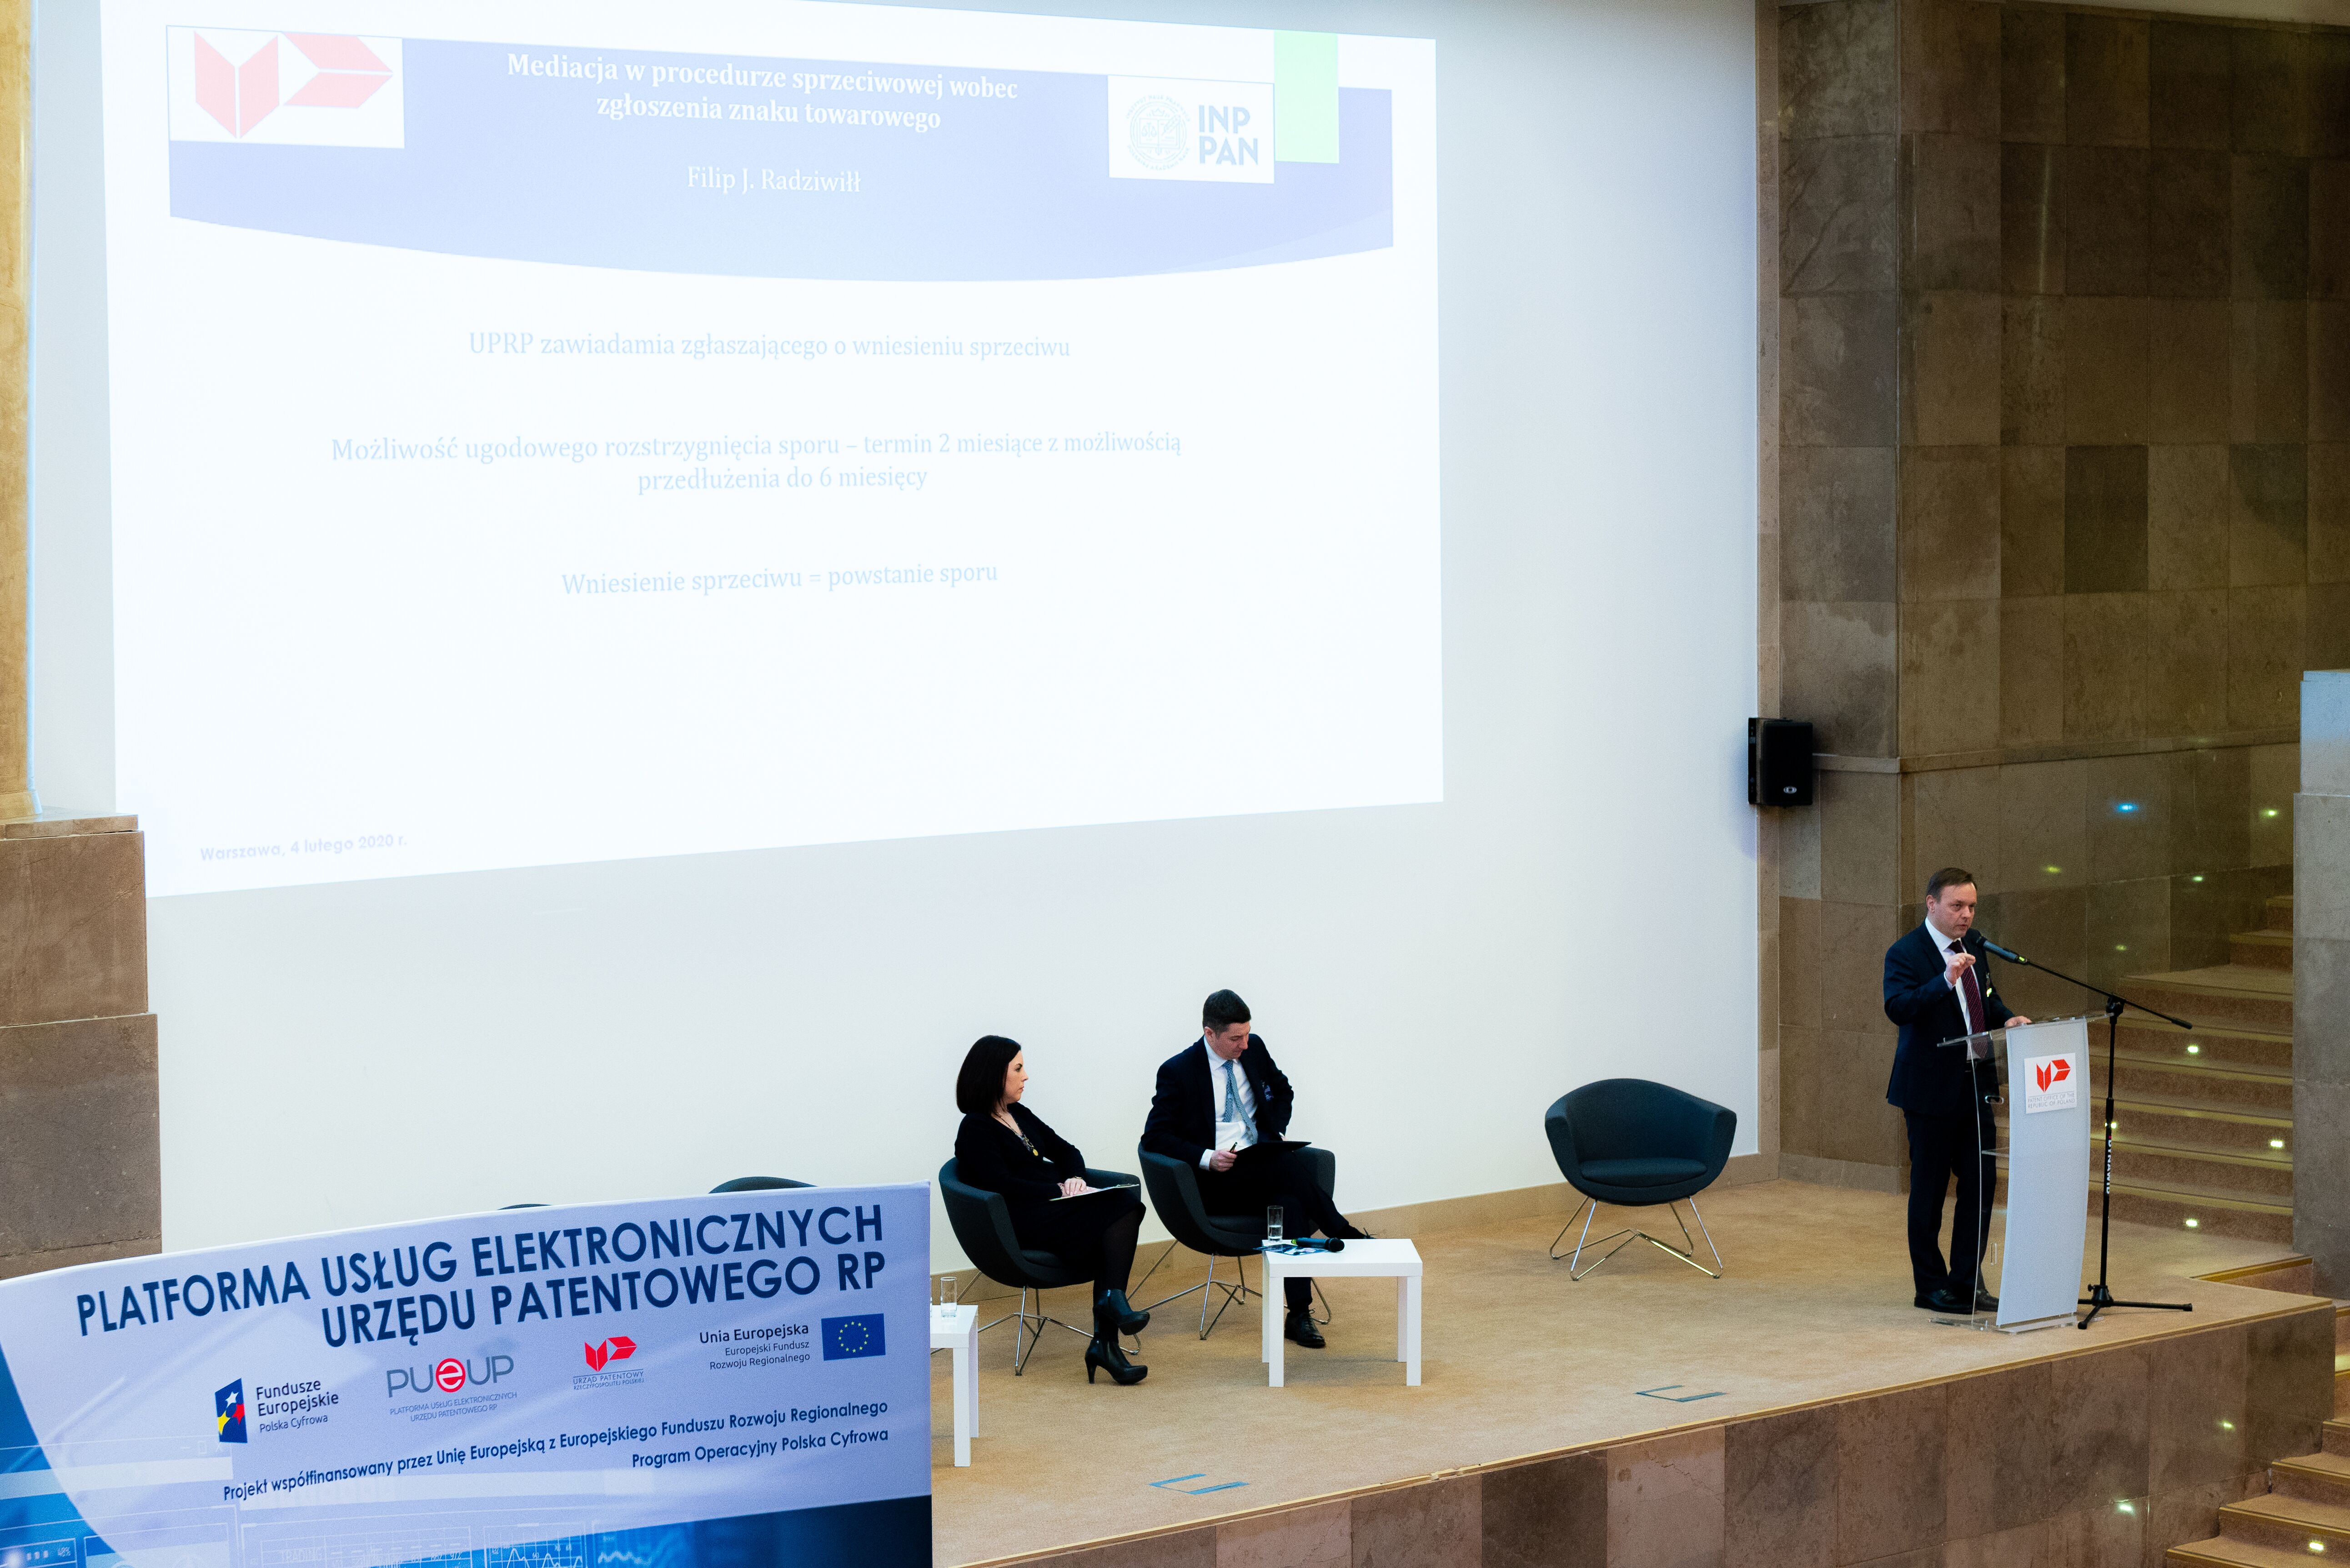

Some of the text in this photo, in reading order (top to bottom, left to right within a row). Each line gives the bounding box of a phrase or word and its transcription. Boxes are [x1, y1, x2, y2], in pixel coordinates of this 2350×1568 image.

[508, 54, 1017, 101] Mediacja w procedurze sprzeciwowej wobec
[597, 93, 940, 132] zgłoszenia znaku towarowego
[1199, 105, 1250, 134] INP
[1199, 136, 1258, 165] PAN
[688, 166, 860, 194] Filip J. Radziwiłł
[470, 332, 1070, 361] UPRP zawiadamia zgłaszającego o wniesieniu sprzeciwu
[332, 437, 457, 460] Możliwość
[466, 436, 598, 464] ugodowego
[606, 435, 771, 462] rozstrzygnięcia
[779, 440, 839, 460] sporu
[864, 433, 931, 453] termin
[939, 433, 949, 452] 2
[958, 433, 1042, 457] miesiące
[1048, 438, 1058, 452] z
[1065, 431, 1181, 456] możliwością
[638, 466, 927, 496] przedłużenia do 6 miesięcy
[562, 571, 685, 594] Wniesienie
[692, 568, 802, 596] sprzeciwu
[829, 564, 934, 592] powstanie
[940, 567, 997, 588] sporu
[200, 834, 407, 861] Warszawa, 4 lutego 2020 r.
[76, 1204, 885, 1336] PLATFORMA USŁUG ELEKTRONICZNYCH
[322, 1251, 885, 1347] URZĘDU PATENTOWEGO RP
[700, 1323, 810, 1343] Unia Europejska
[710, 1353, 811, 1371] Rozwoju Regionalnego
[725, 1341, 809, 1356] Europejski Fundusz
[256, 1381, 321, 1401] Fundusze
[573, 1371, 644, 1384] URZĄD PATENTOWY
[574, 1382, 620, 1390] RZECZYPOSPOLITEJ
[258, 1392, 338, 1417] Europejskie
[390, 1392, 517, 1415] PLATFORMA USŁUG ELEKTRONICZNYCH
[410, 1412, 437, 1422] URZĘDU
[438, 1406, 487, 1418] PATENTOWEGO
[259, 1415, 328, 1432] Polska Cyfrowa
[224, 1402, 888, 1500] Projekt współfinansowany przez Unię Europejską z Europejskiego Funduszu Rozwoju Regionalnego
[633, 1430, 888, 1468] Program Operacyjny Polska Cyfrowa
